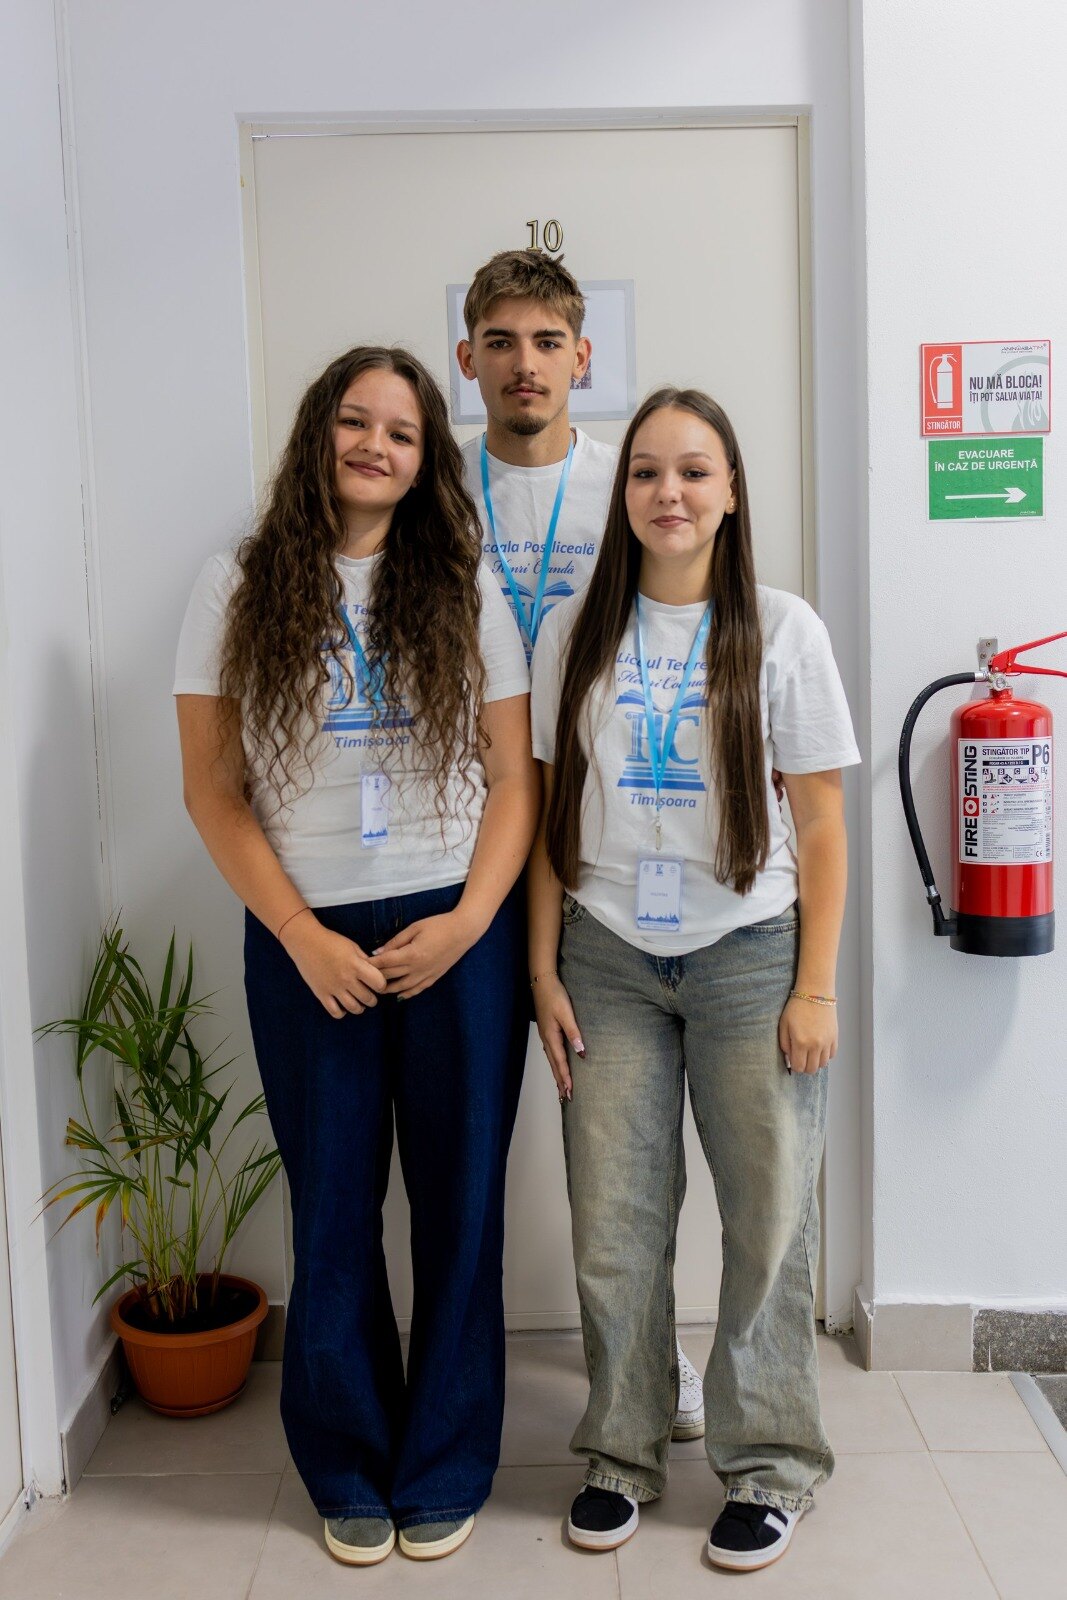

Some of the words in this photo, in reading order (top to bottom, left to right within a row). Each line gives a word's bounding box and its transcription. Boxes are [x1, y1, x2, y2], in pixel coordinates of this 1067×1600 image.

[526, 219, 563, 253] 10
[970, 376, 984, 390] NU
[986, 374, 1003, 390] MĂ
[1005, 375, 1042, 389] BLOCA!
[980, 392, 993, 402] POT
[995, 391, 1018, 401] SALVA
[926, 418, 961, 430] STINGĂTOR
[958, 449, 1014, 460] EVACUARE
[934, 460, 945, 472] ÎN
[947, 461, 969, 472] CAZ
[971, 460, 986, 471] DE
[988, 458, 1038, 472] URGENȚĂ
[524, 541, 595, 555] Posliceală
[1020, 747, 1030, 755] TIP
[1032, 744, 1050, 765] P6
[964, 817, 978, 857] FIRE
